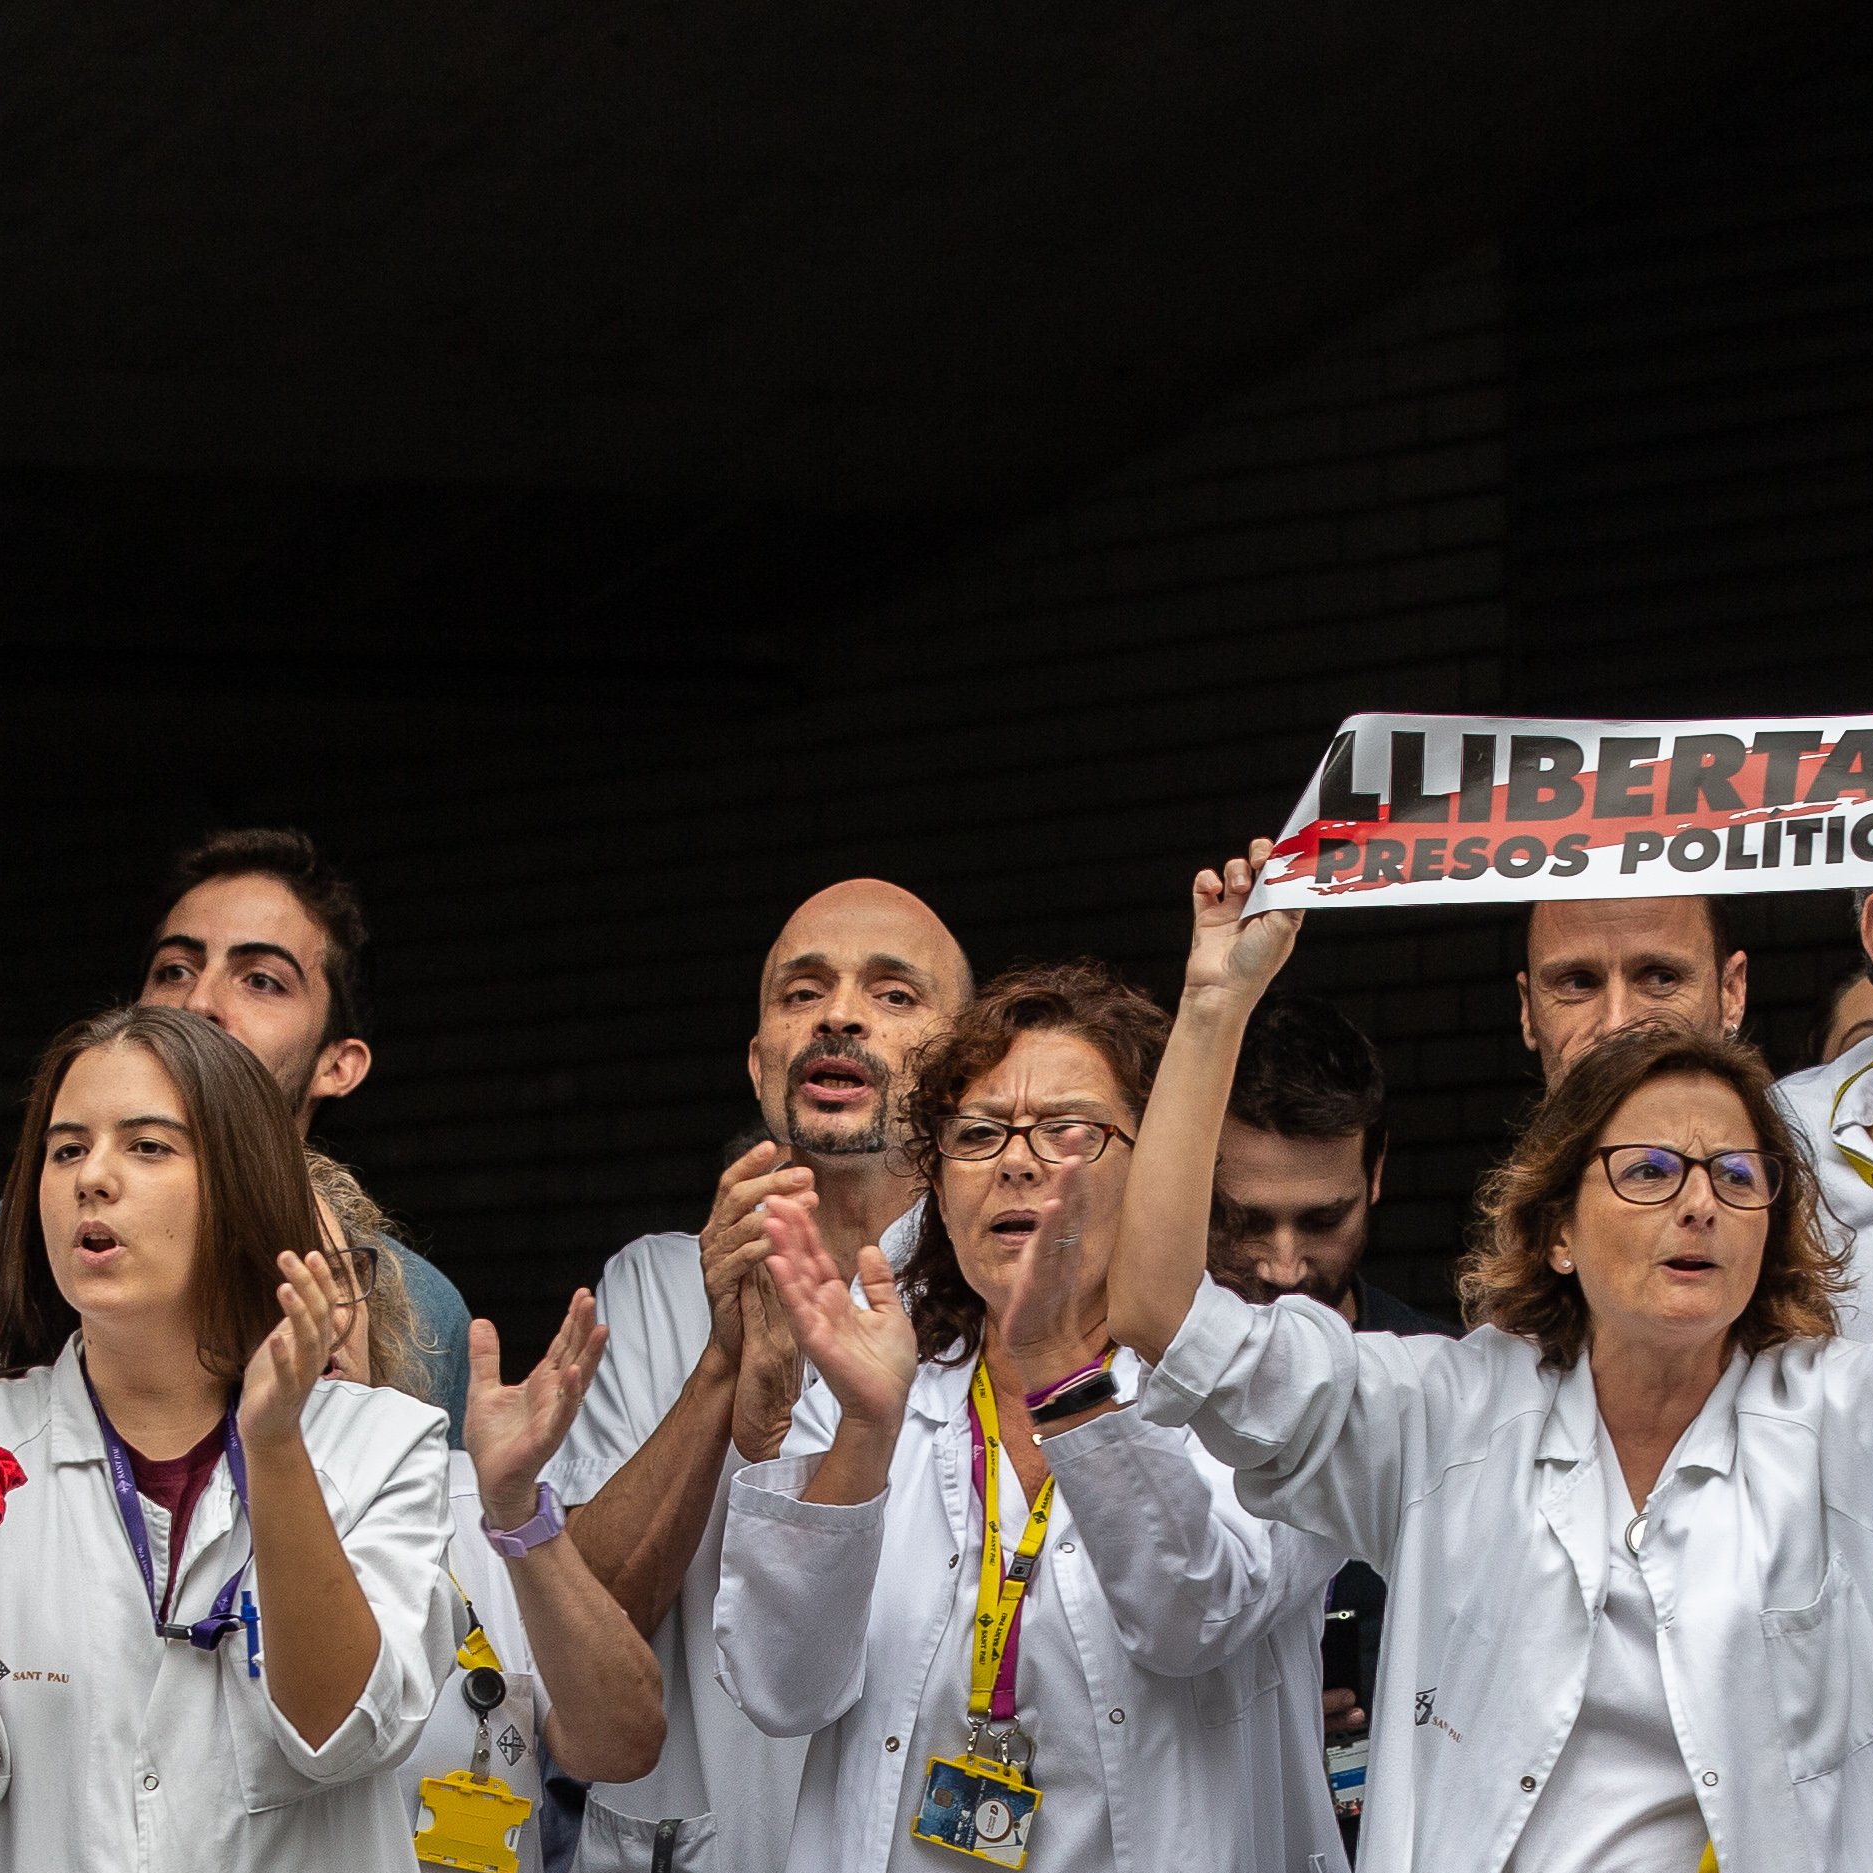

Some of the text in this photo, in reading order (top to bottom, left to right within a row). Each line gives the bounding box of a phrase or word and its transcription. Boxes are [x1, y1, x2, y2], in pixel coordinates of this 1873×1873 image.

[1315, 833, 1591, 884] PRESOS
[13, 1671, 70, 1684] SANT PAU
